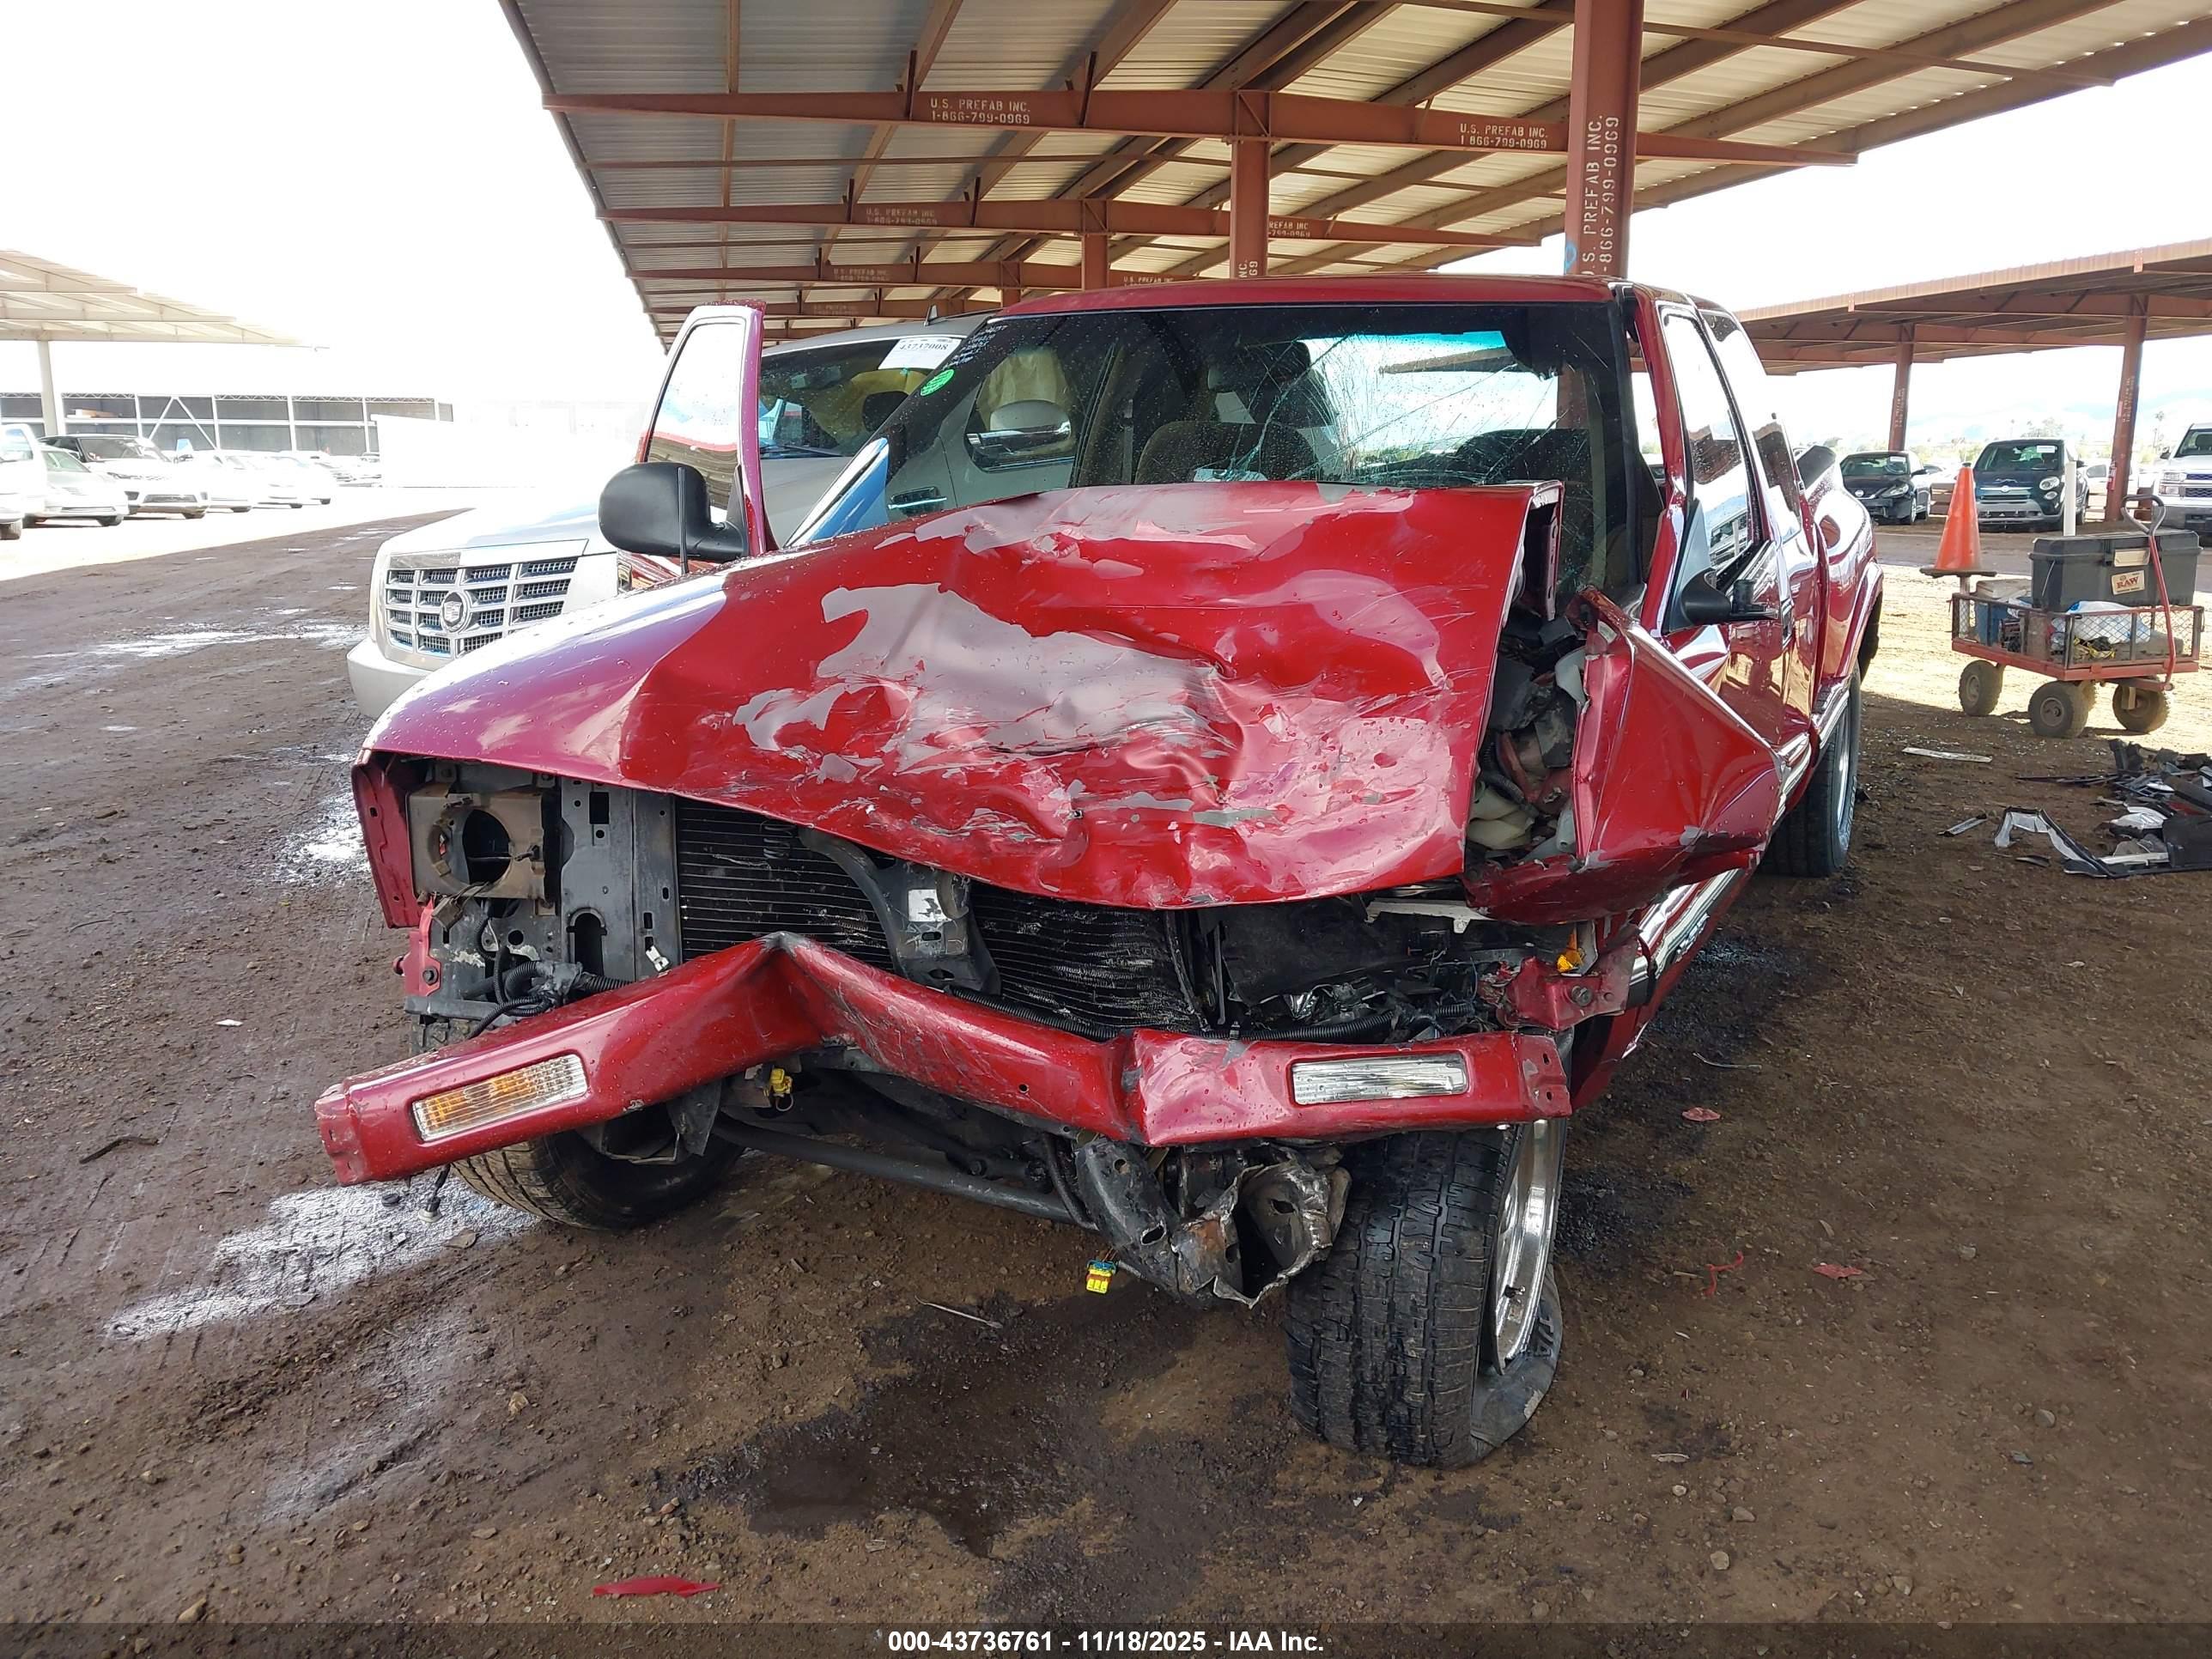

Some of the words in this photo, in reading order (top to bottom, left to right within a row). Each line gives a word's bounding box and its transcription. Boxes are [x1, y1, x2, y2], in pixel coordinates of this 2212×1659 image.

[958, 99, 1003, 112] PREFAB
[1009, 100, 1030, 112] INC.
[932, 110, 1030, 125] 1-866-799-0969
[1460, 123, 1480, 135] U.S.
[1485, 125, 1524, 137] PREFAB
[1529, 126, 1548, 138] INC.
[1587, 115, 1603, 150] INC.
[1583, 161, 1601, 234] PREFAB
[2116, 576, 2139, 589] RAW
